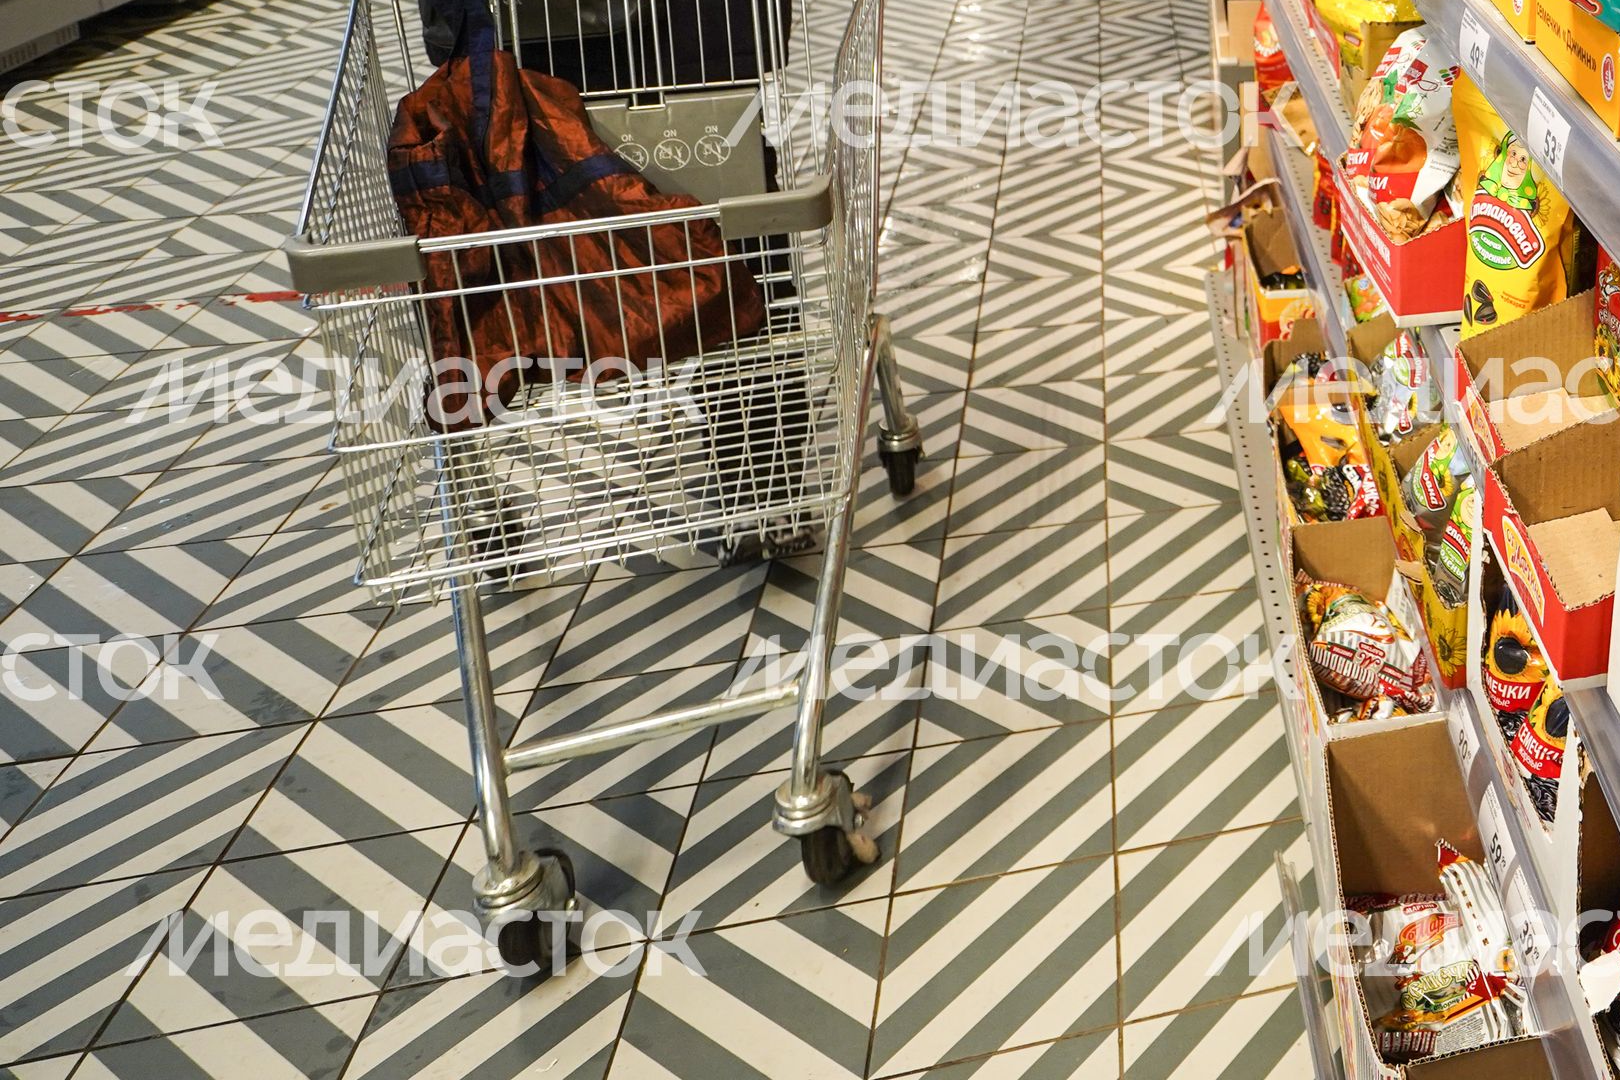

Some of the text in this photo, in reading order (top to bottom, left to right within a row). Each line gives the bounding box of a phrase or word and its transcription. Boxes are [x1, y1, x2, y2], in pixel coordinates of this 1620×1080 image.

[1535, 1, 1598, 73] семечки «Джинн»
[1543, 128, 1558, 166] 53
[1486, 673, 1531, 701] МЕЧКИ
[1489, 831, 1502, 865] 59
